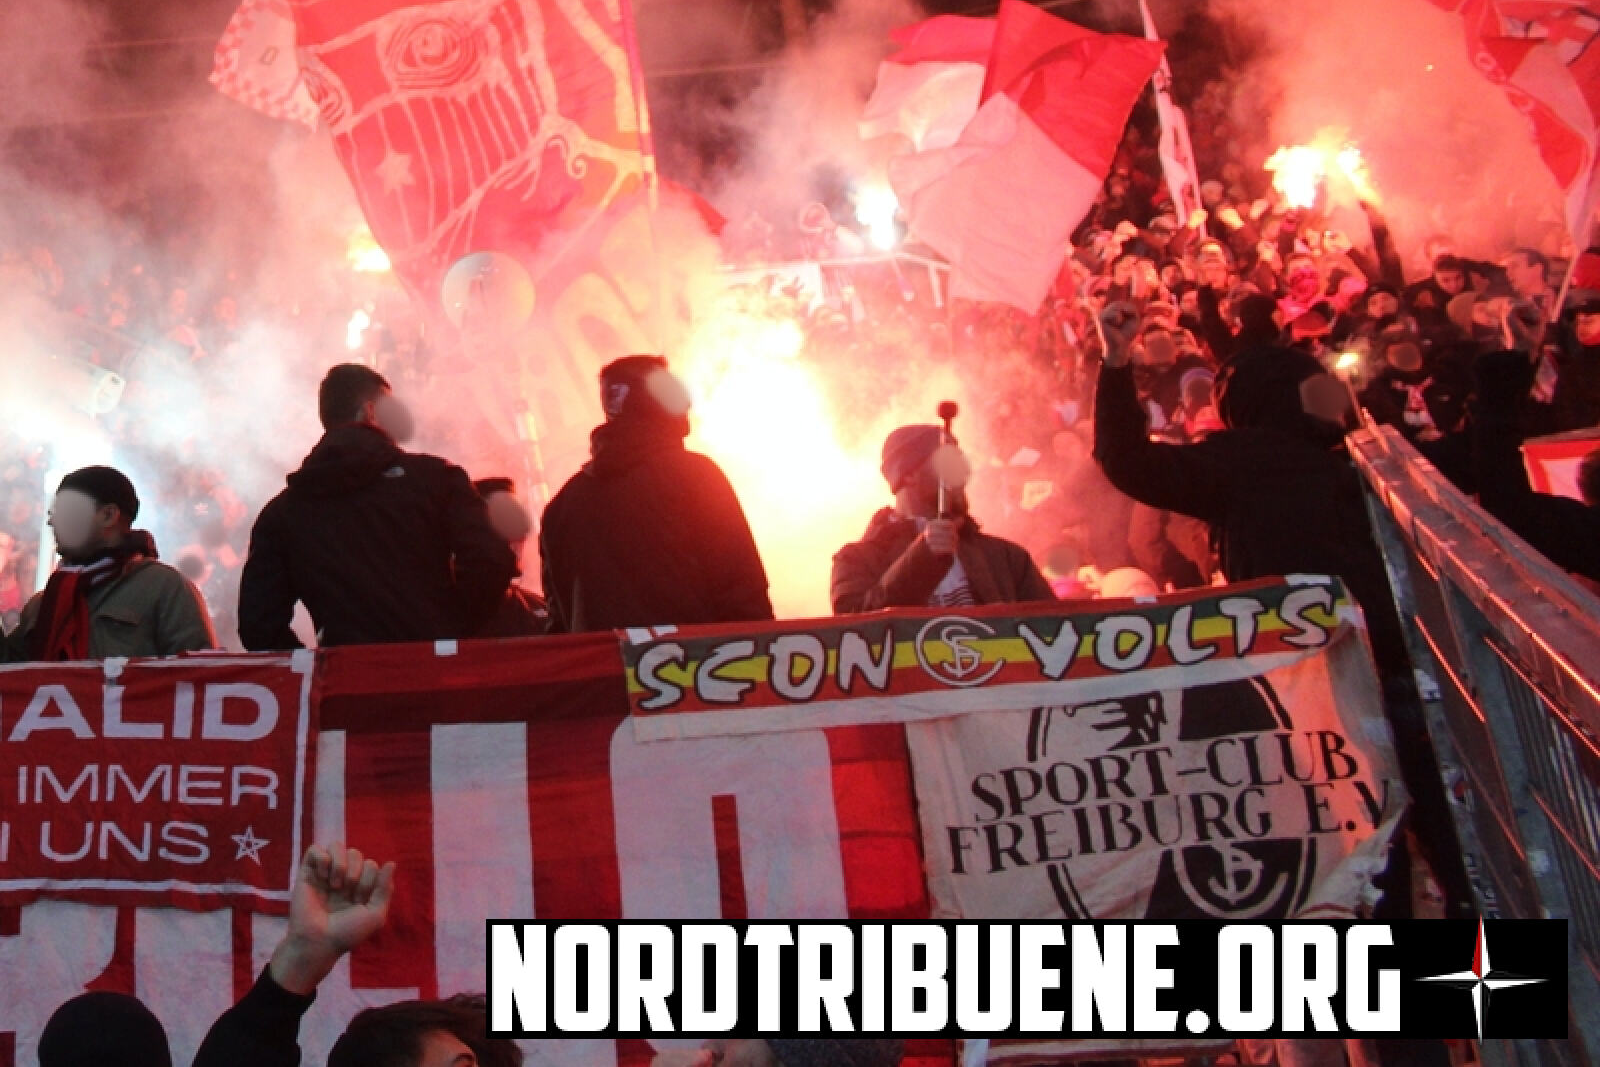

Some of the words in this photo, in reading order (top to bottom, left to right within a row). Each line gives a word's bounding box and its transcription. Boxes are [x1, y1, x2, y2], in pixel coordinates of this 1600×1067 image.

[636, 630, 895, 711] SCON
[1017, 586, 1338, 679] VOLTS
[18, 764, 279, 809] IMMER
[971, 730, 1358, 823] SPORT-CLUB
[40, 822, 211, 865] UNS
[946, 789, 1272, 874] FREIBURG
